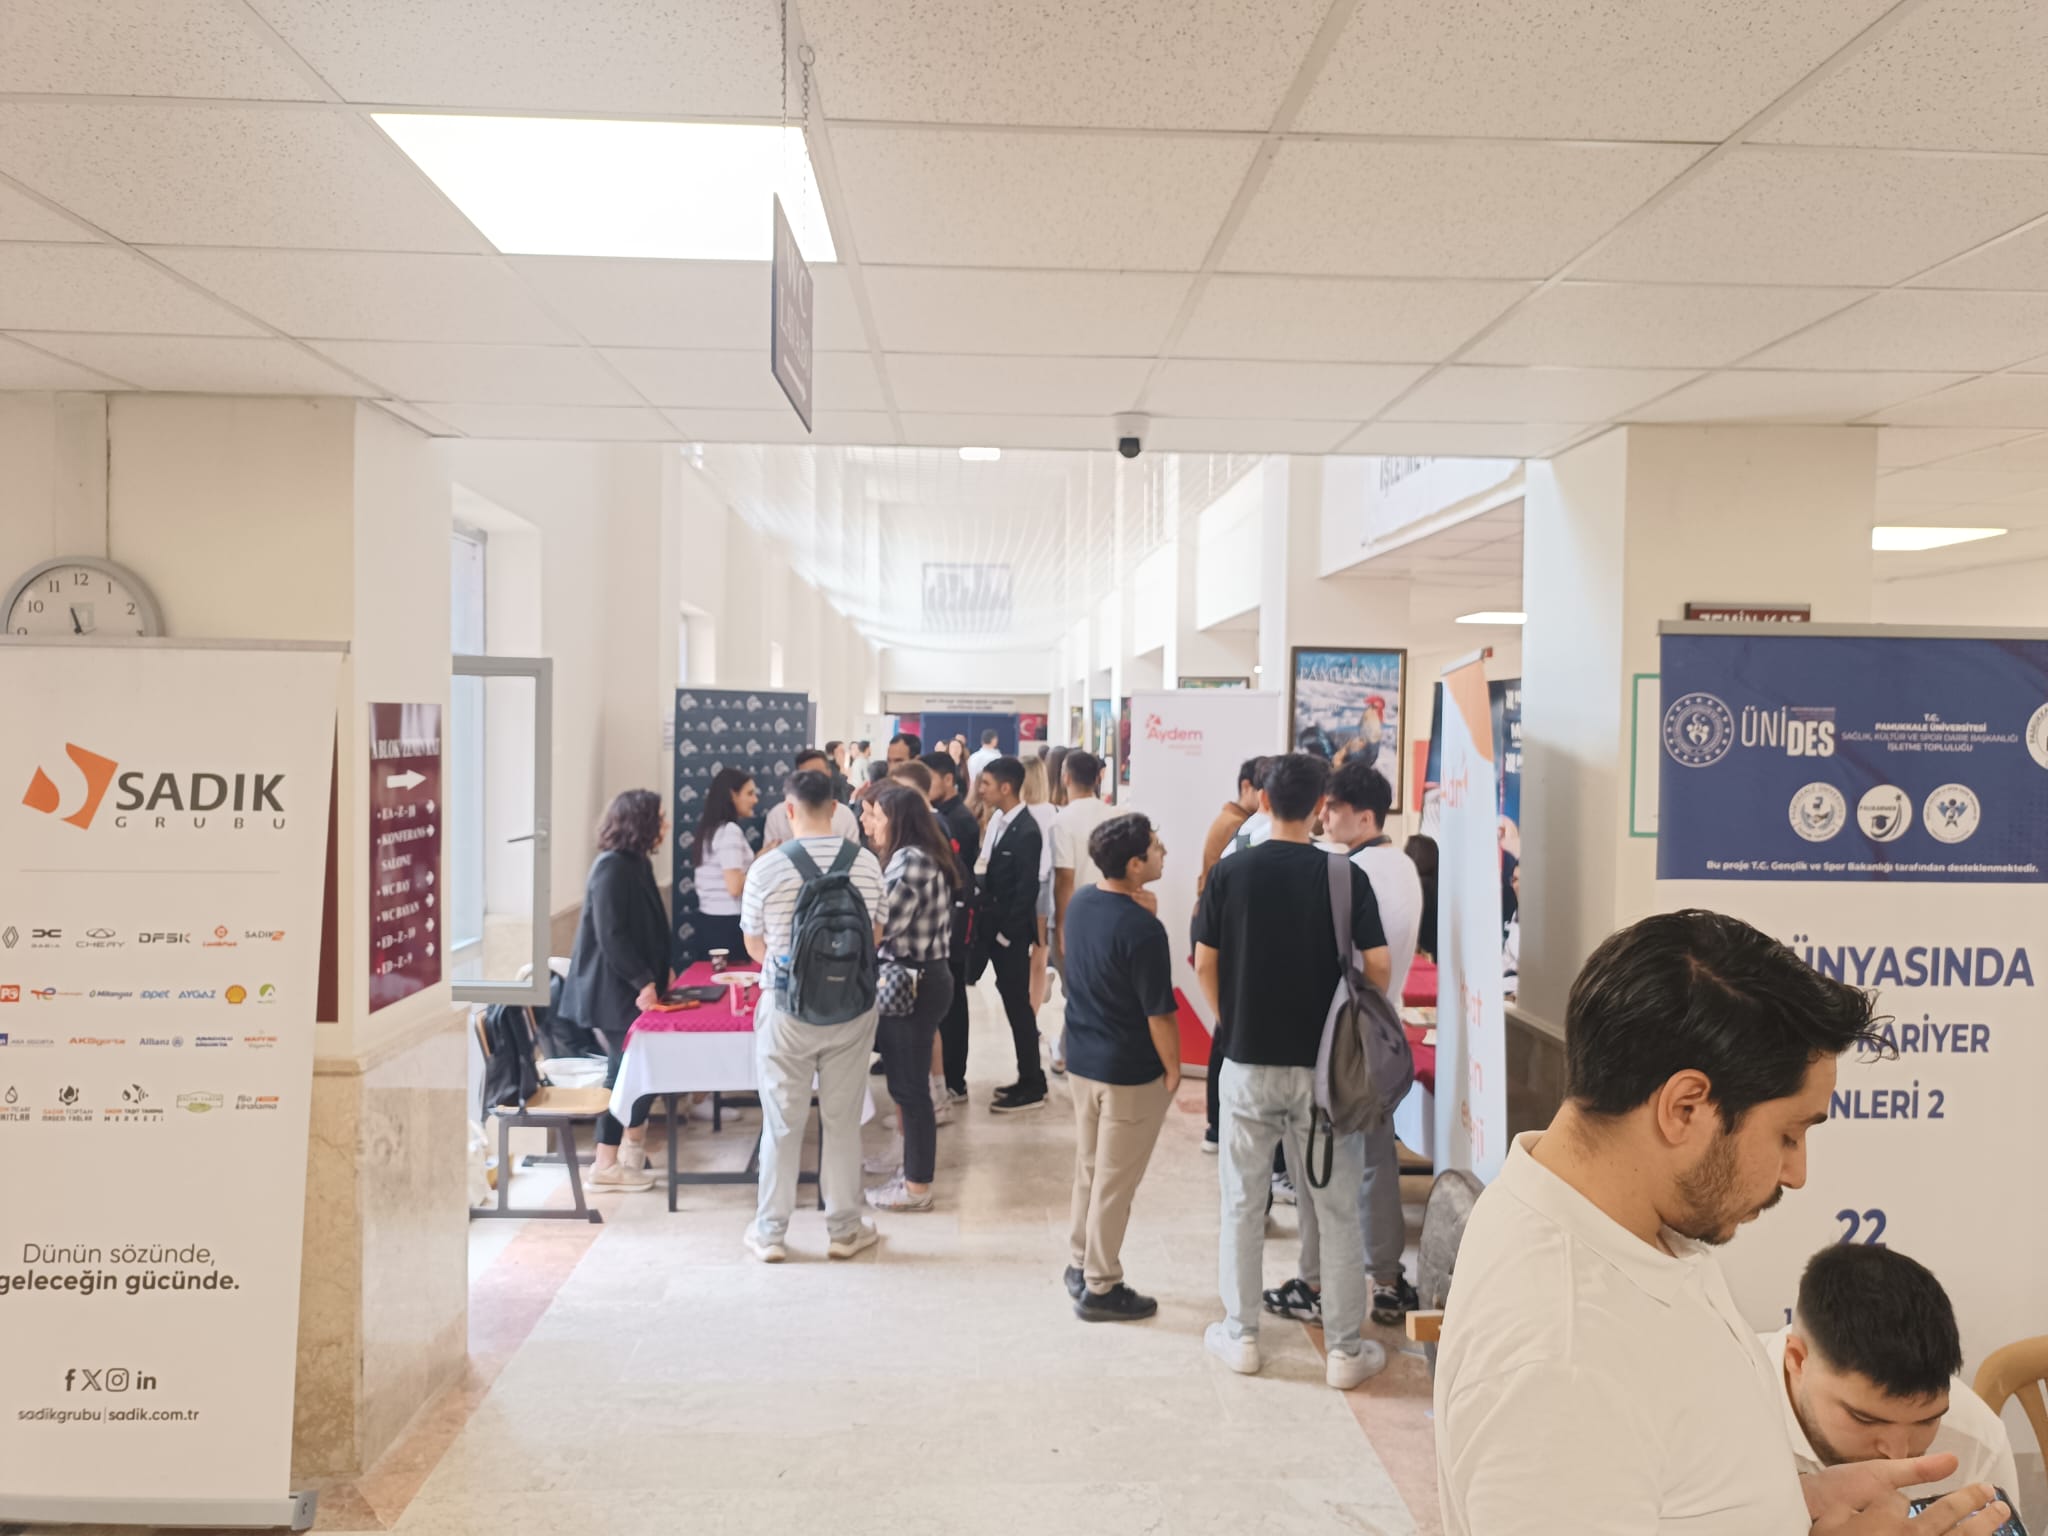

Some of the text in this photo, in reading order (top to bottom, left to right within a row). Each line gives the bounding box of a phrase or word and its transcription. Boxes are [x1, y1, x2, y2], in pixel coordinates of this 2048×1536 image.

[48, 579, 61, 593] 11
[73, 572, 89, 586] 12
[107, 581, 112, 594] 1
[27, 599, 44, 614] 10
[127, 602, 136, 616] 2
[1875, 722, 1928, 732] PAMUKKALE
[1147, 727, 1202, 744] Aydem
[1907, 732, 1918, 741] VE
[115, 771, 286, 812] SADIK
[1706, 860, 1721, 870] Bu
[1722, 860, 1749, 873] proje
[1771, 860, 1808, 873] Gençlik
[1809, 862, 1821, 871] ve
[1823, 861, 1846, 874] Spor
[1848, 861, 1893, 874] Bakanlığı
[1895, 861, 1945, 872] tarafından
[138, 932, 191, 944] DFSK
[178, 990, 216, 999] AYGAZ
[1857, 1014, 1990, 1052] KARİYER
[139, 1037, 170, 1046] Allianz
[1927, 1090, 1945, 1119] 2
[1835, 1208, 1887, 1248] 22
[23, 1243, 216, 1267] Dünün sözünde,
[0, 1269, 241, 1295] geleceğin gücünde.
